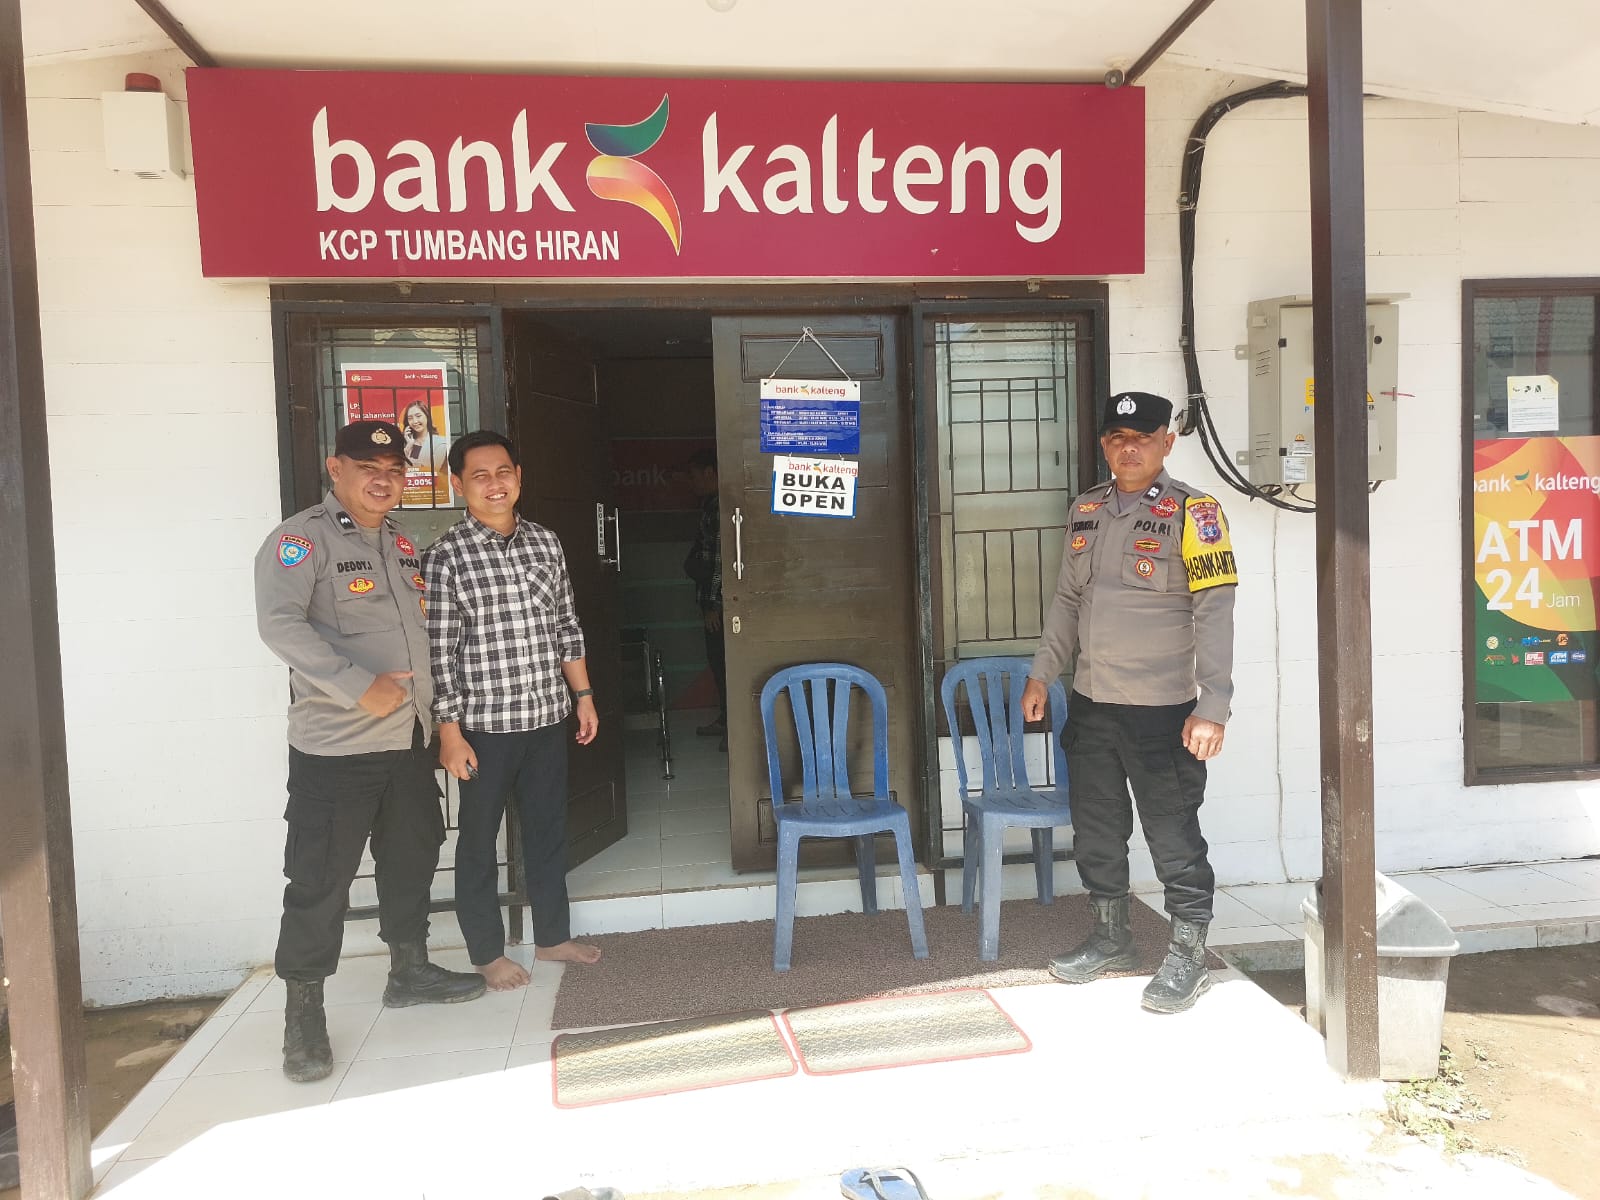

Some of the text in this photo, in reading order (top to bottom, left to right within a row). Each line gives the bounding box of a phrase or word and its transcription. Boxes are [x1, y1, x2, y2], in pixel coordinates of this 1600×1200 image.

[312, 106, 1062, 243] bank kalteng
[319, 230, 620, 261] KCP TUMBANG HIRAN
[775, 385, 846, 397] bank kalteng
[788, 461, 858, 477] bank kalteng
[782, 473, 845, 491] BUKA
[1535, 472, 1600, 494] kalteng
[782, 493, 845, 510] OPEN
[1133, 520, 1171, 536] POLRI
[1476, 518, 1583, 564] ATM
[1485, 567, 1581, 611] 24 Jam
